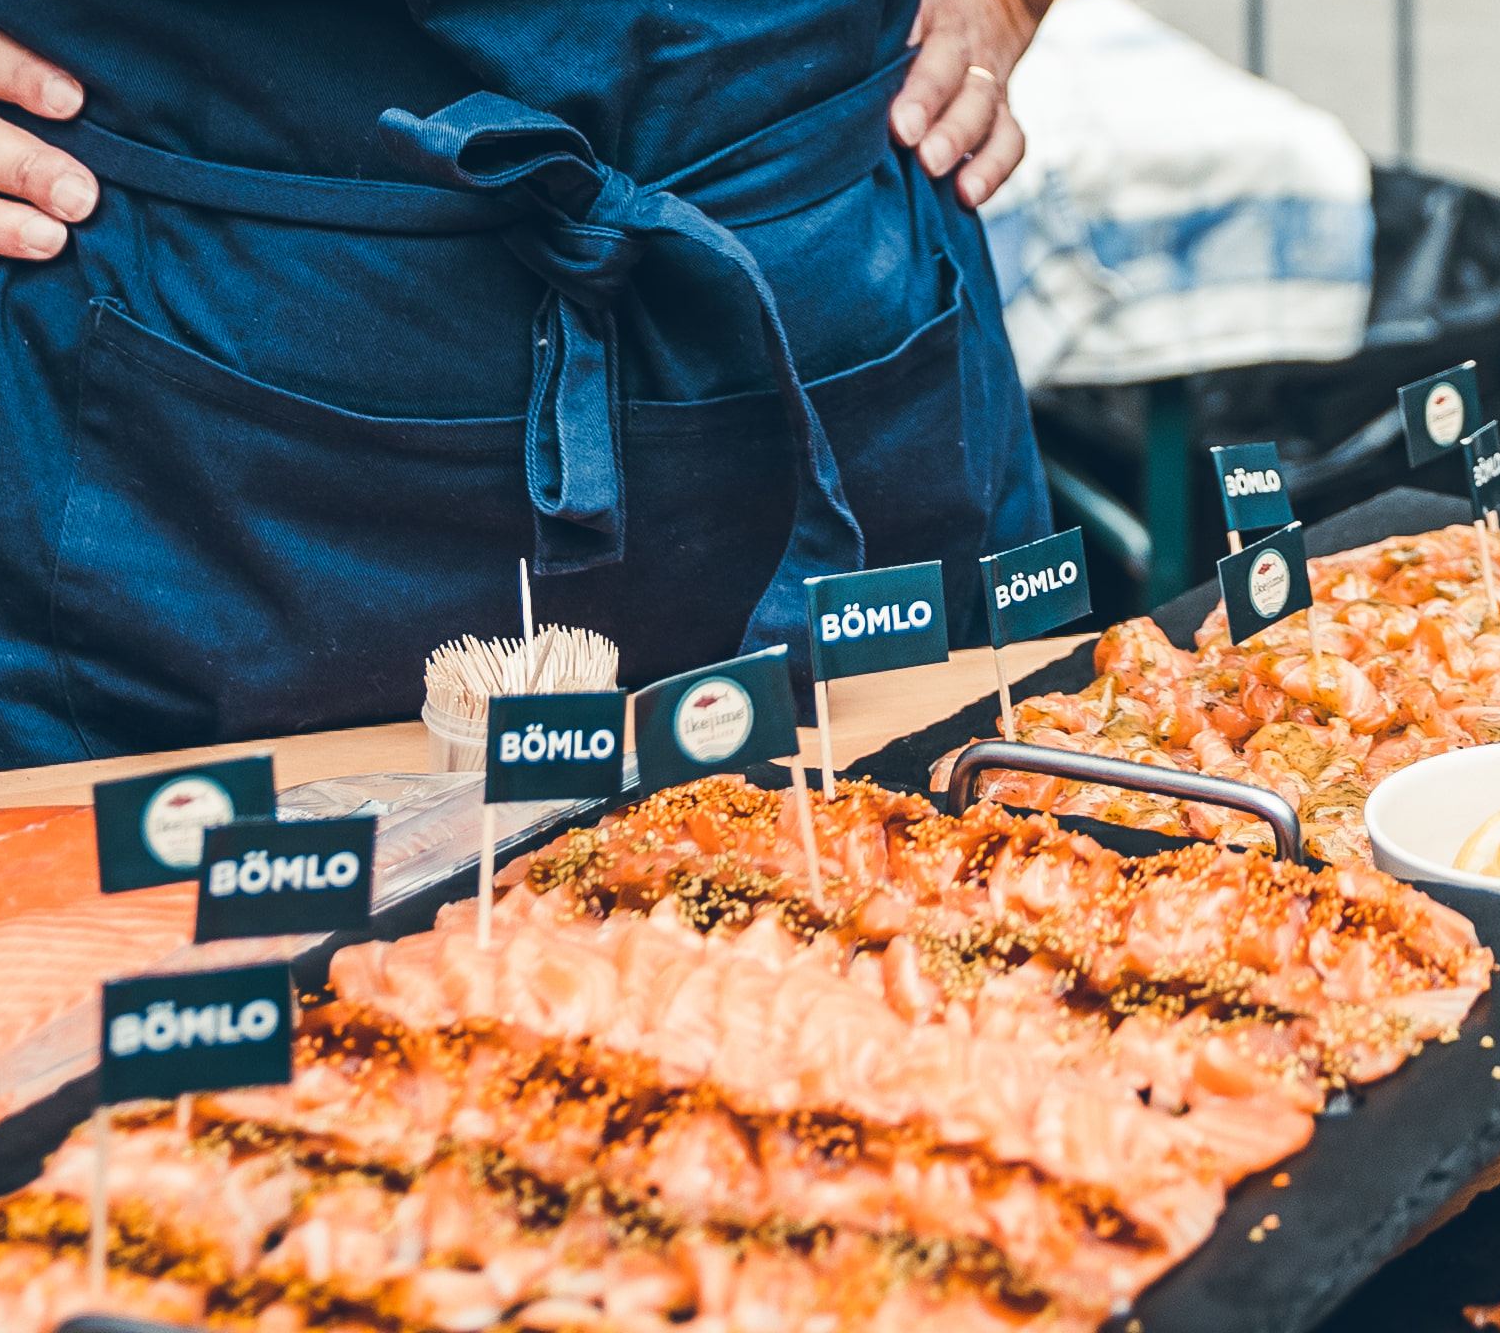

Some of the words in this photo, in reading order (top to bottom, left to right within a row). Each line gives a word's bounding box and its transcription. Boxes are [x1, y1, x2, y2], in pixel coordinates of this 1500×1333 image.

[1224, 468, 1282, 497] BÖMLO
[993, 559, 1079, 611] BÖMLO
[820, 599, 933, 643] BÖMLO
[499, 724, 616, 764] BÖMLO
[208, 849, 361, 897] BÖMLO
[109, 998, 281, 1058] BÖMLO
